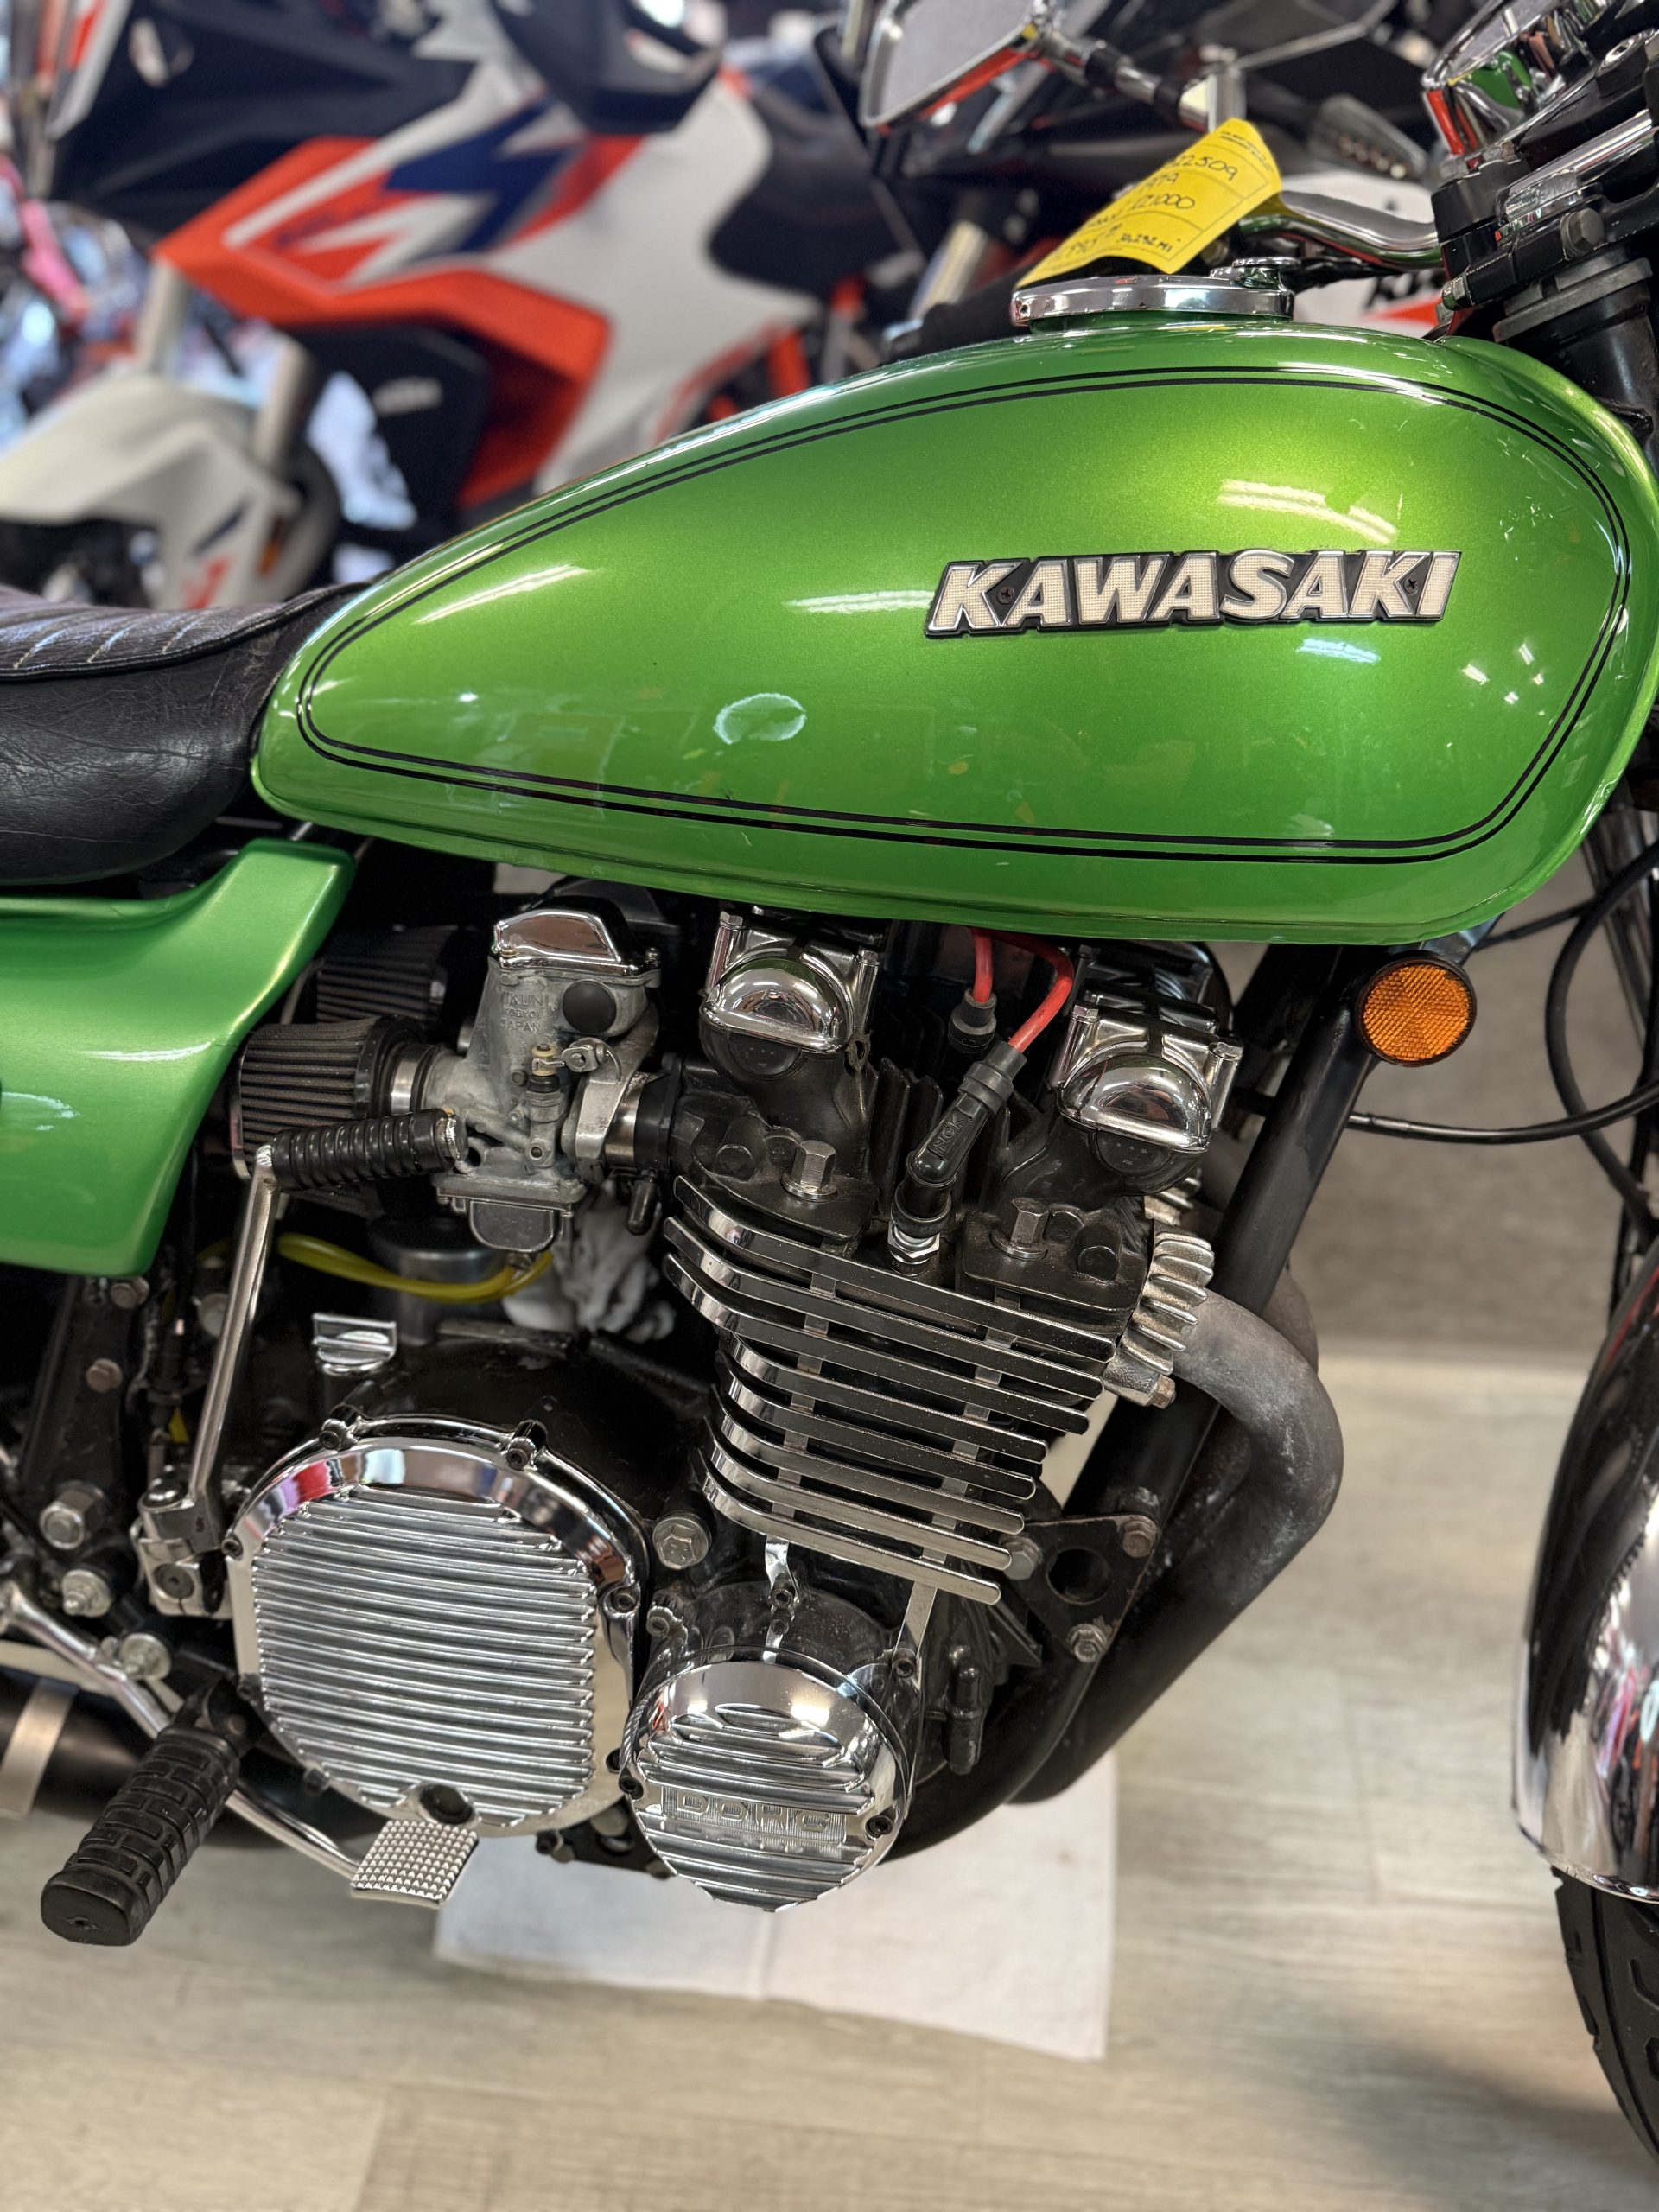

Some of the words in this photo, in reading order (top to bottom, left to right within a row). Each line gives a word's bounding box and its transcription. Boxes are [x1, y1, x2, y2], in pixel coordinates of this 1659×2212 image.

[927, 548, 1461, 633] KAWASAKI
[500, 1018, 541, 1033] JAPAN
[932, 1114, 964, 1153] NGK
[677, 1793, 830, 1833] DOHC
